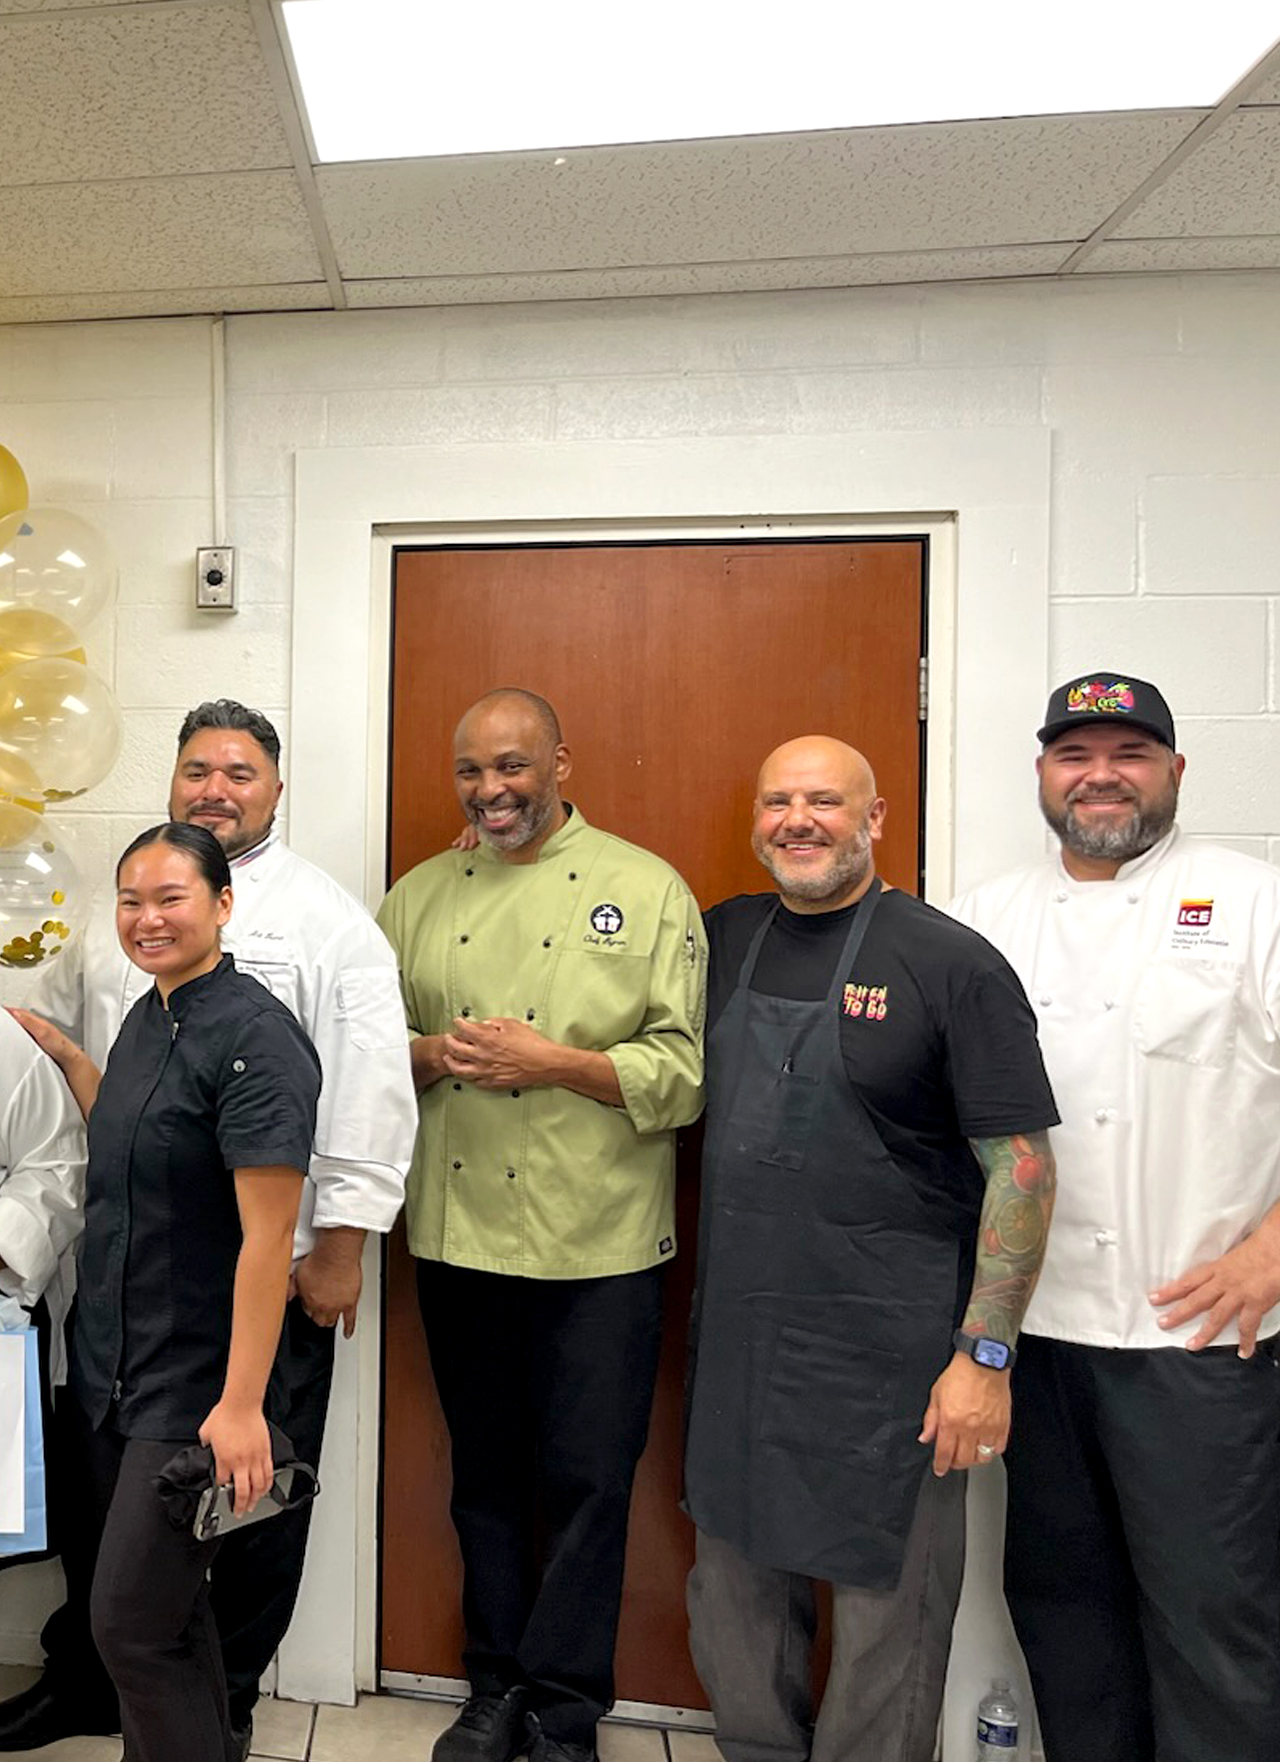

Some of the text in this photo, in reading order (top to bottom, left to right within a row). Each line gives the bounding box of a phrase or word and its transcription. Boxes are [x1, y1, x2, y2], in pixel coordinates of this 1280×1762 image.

[1180, 910, 1210, 923] ICE
[843, 997, 887, 1021] TO GO
